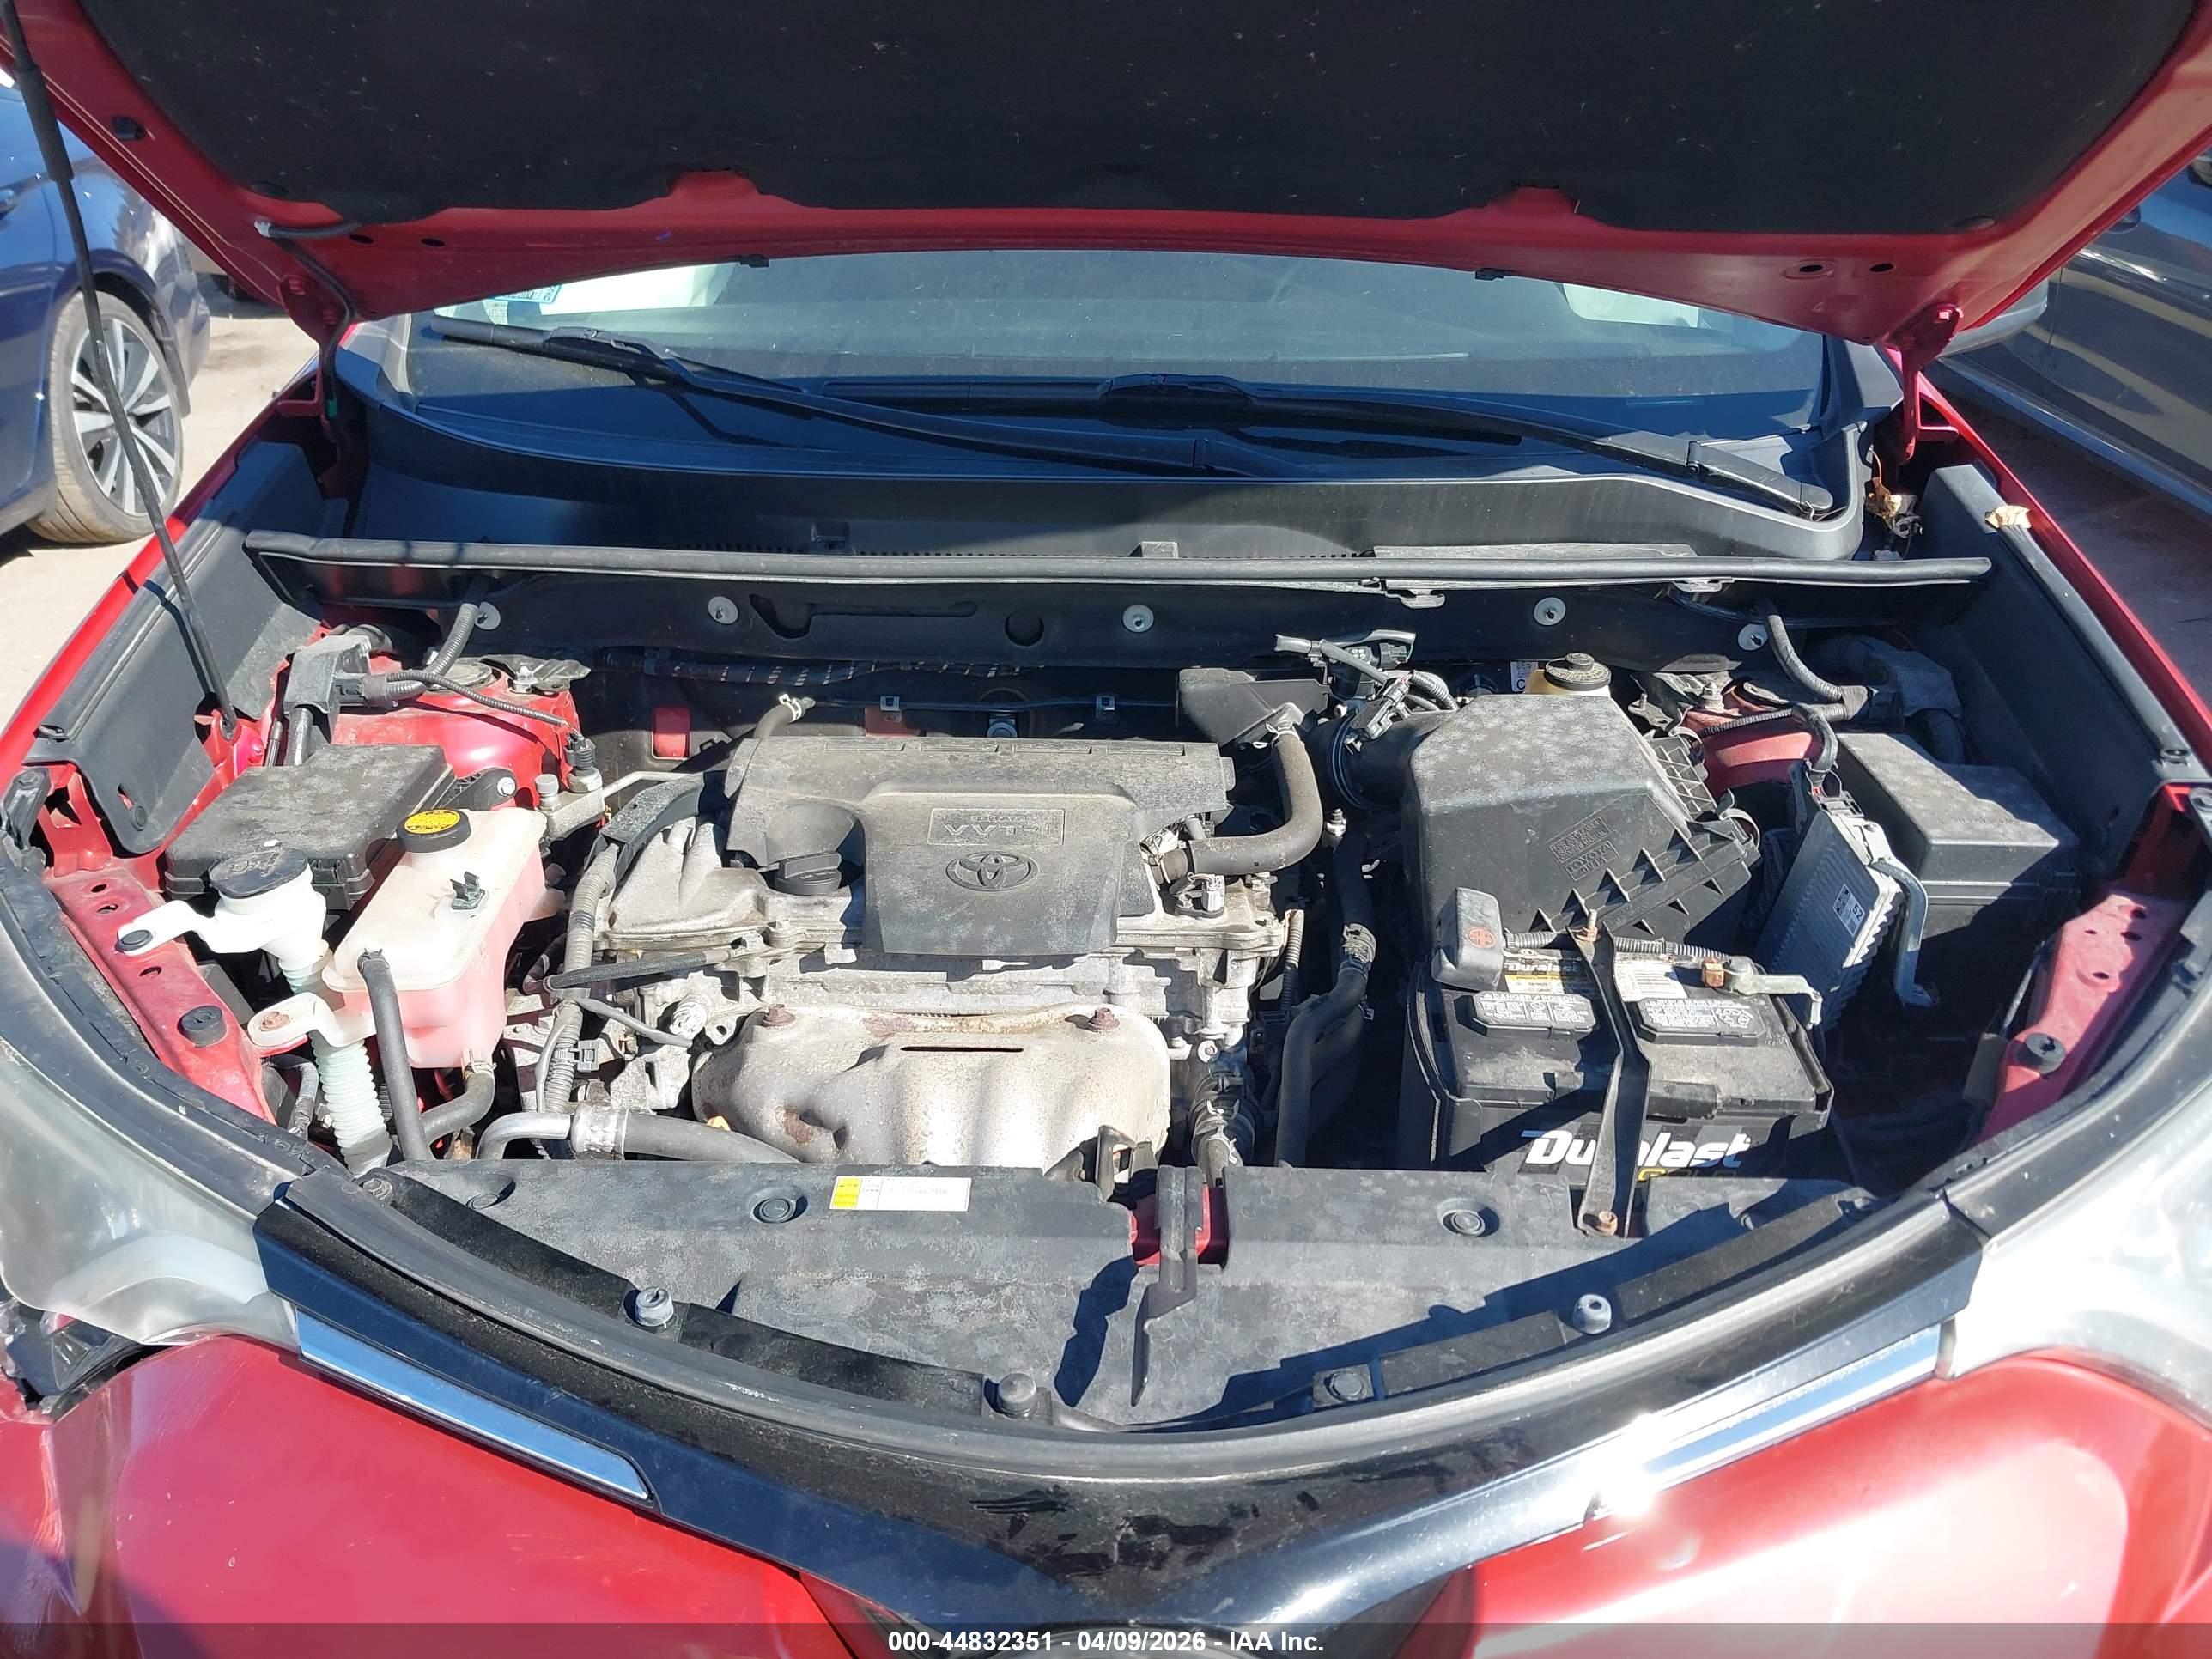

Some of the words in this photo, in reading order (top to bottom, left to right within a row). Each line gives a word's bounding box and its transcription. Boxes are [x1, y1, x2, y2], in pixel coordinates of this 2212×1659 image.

[1852, 903, 1863, 921] 52
[1504, 961, 1581, 973] Duralast
[1521, 1130, 1752, 1169] Dulast
